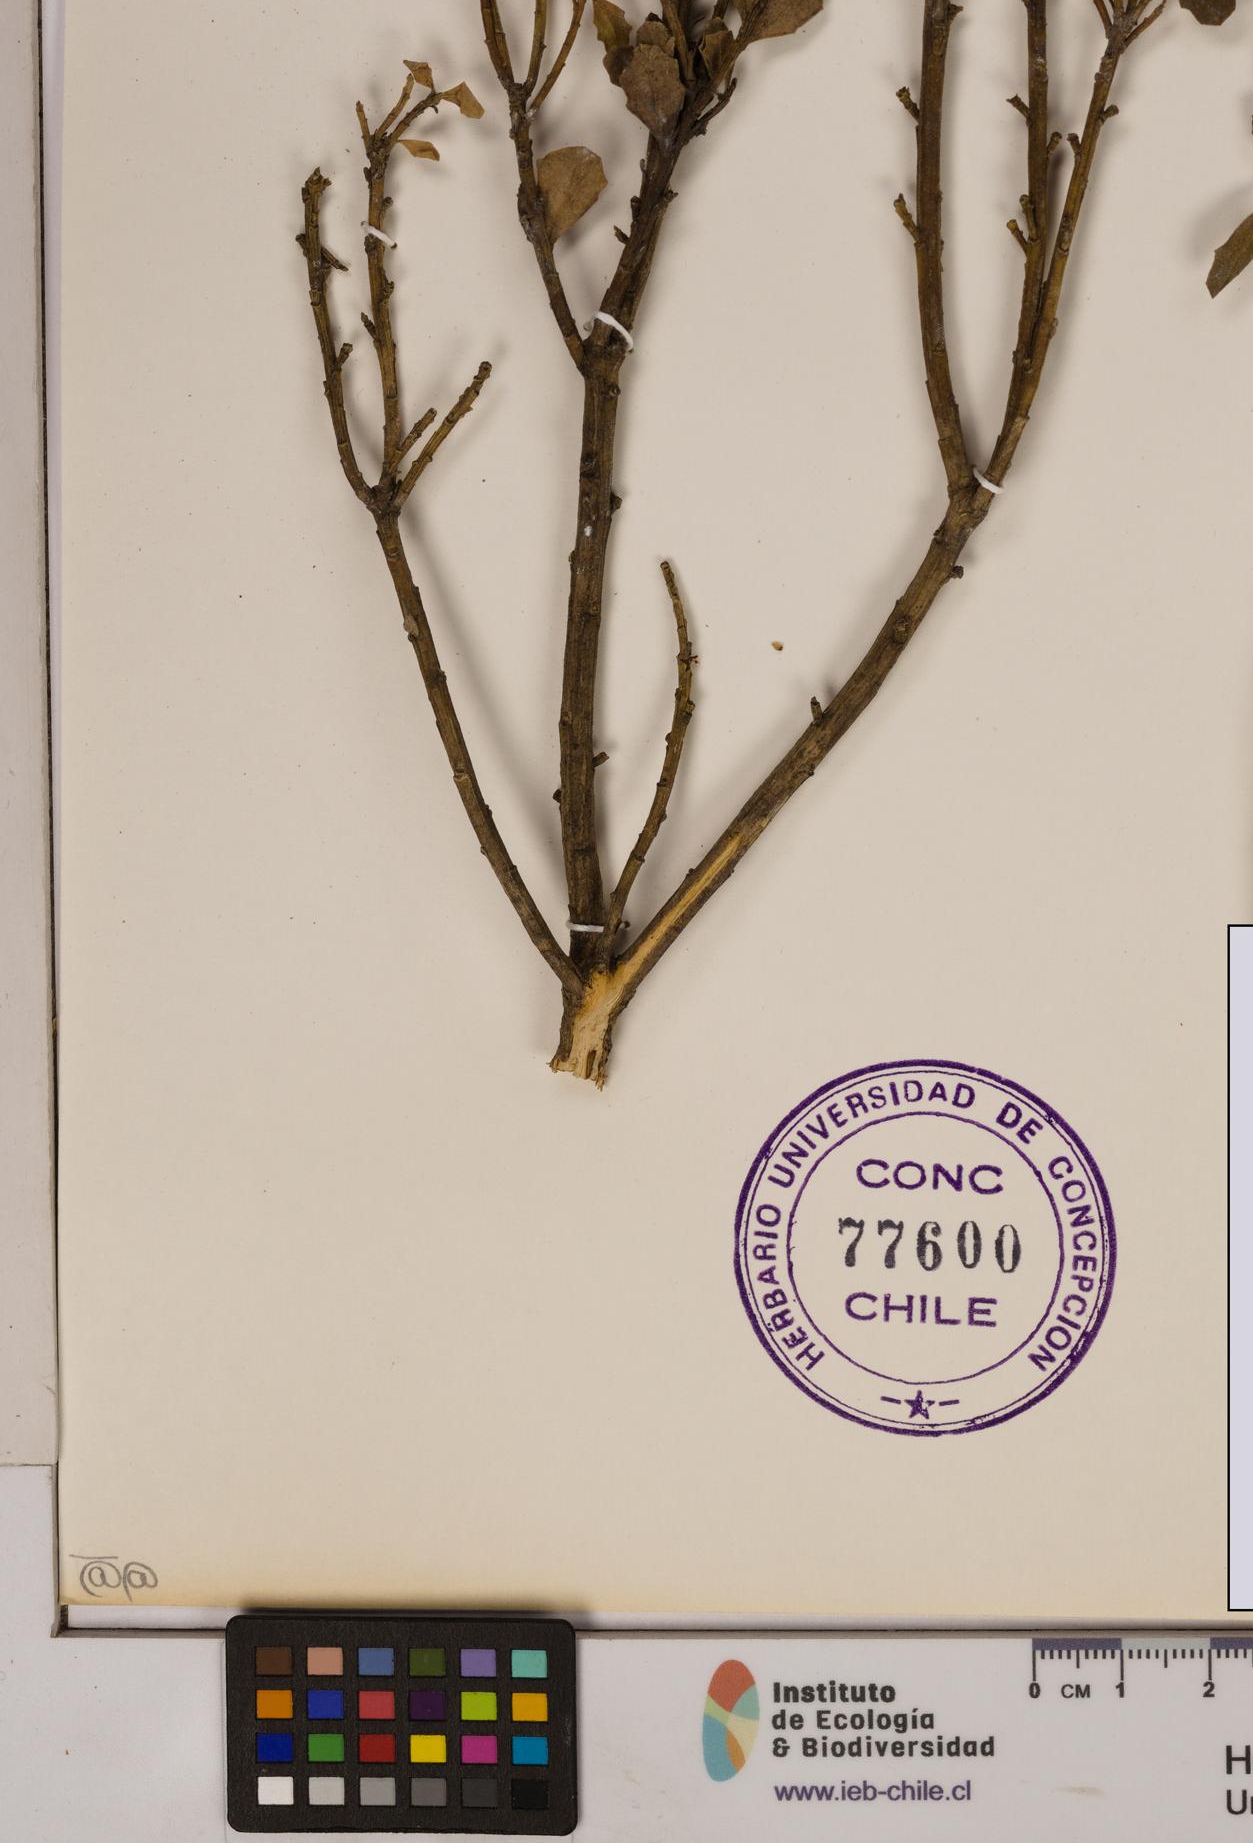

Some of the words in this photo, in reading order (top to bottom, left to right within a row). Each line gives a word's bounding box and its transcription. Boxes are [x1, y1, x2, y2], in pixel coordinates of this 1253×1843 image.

[768, 1079, 976, 1189] UNIVERSIDAD
[995, 1101, 1044, 1145] DE
[855, 1158, 1004, 1195] CONC
[838, 1216, 1022, 1274] 77600
[1026, 1155, 1098, 1373] CONCEPCION
[752, 1203, 826, 1371] HERBARIO
[844, 1291, 998, 1328] CHILE
[773, 1679, 897, 1704] Instituto
[1028, 1681, 1042, 1699] 0
[1060, 1683, 1091, 1699] CM
[1115, 1680, 1125, 1699] 1
[1202, 1679, 1216, 1698] 2
[771, 1708, 805, 1731] de
[816, 1706, 935, 1734] Ecología
[772, 1736, 791, 1758] &
[801, 1734, 995, 1758] Biodiversidad
[773, 1779, 972, 1802] www.ieb-chile.cl
